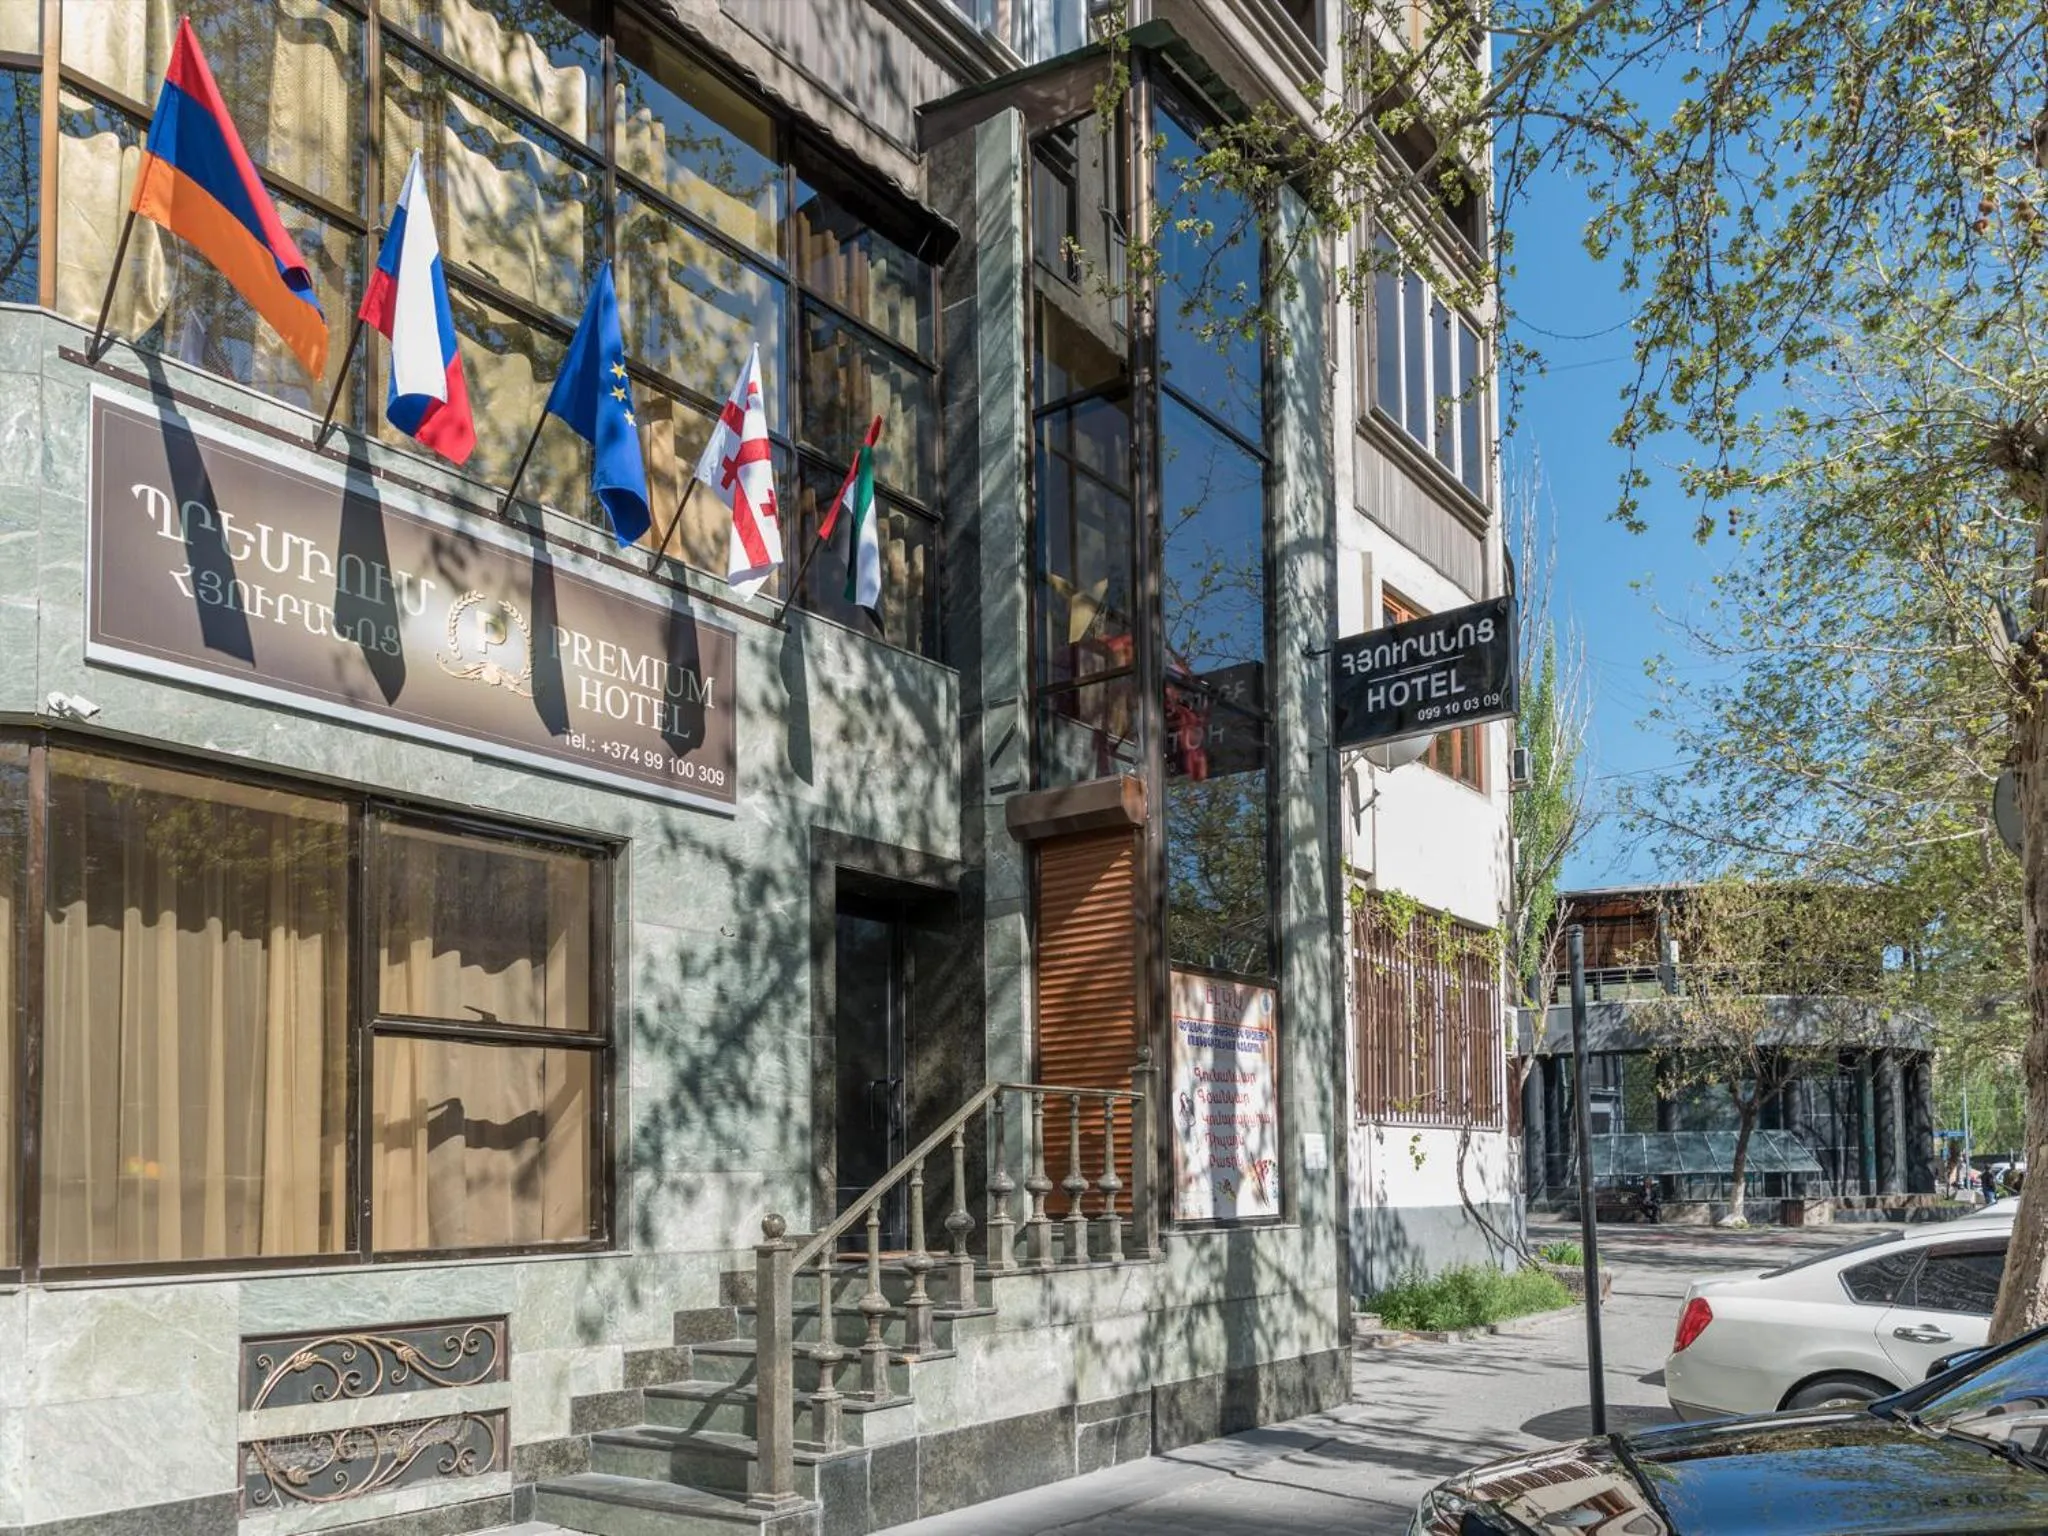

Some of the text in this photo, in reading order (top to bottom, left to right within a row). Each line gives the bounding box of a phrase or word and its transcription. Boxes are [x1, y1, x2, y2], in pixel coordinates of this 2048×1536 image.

[130, 483, 436, 616] ՊՐԵՄԻՈՒՄ
[169, 563, 401, 656] ՀՅՈՒՐԱՆՈՑ
[550, 624, 716, 709] PREMIUM
[1341, 617, 1495, 675] ՀՅՈՒՐԱՆՈՑ
[578, 675, 691, 739] HOTEL
[1367, 669, 1466, 712] HOTEL
[1417, 692, 1500, 721] 099 10 03 09
[562, 727, 725, 786] Tel.: +374 99 100 309
